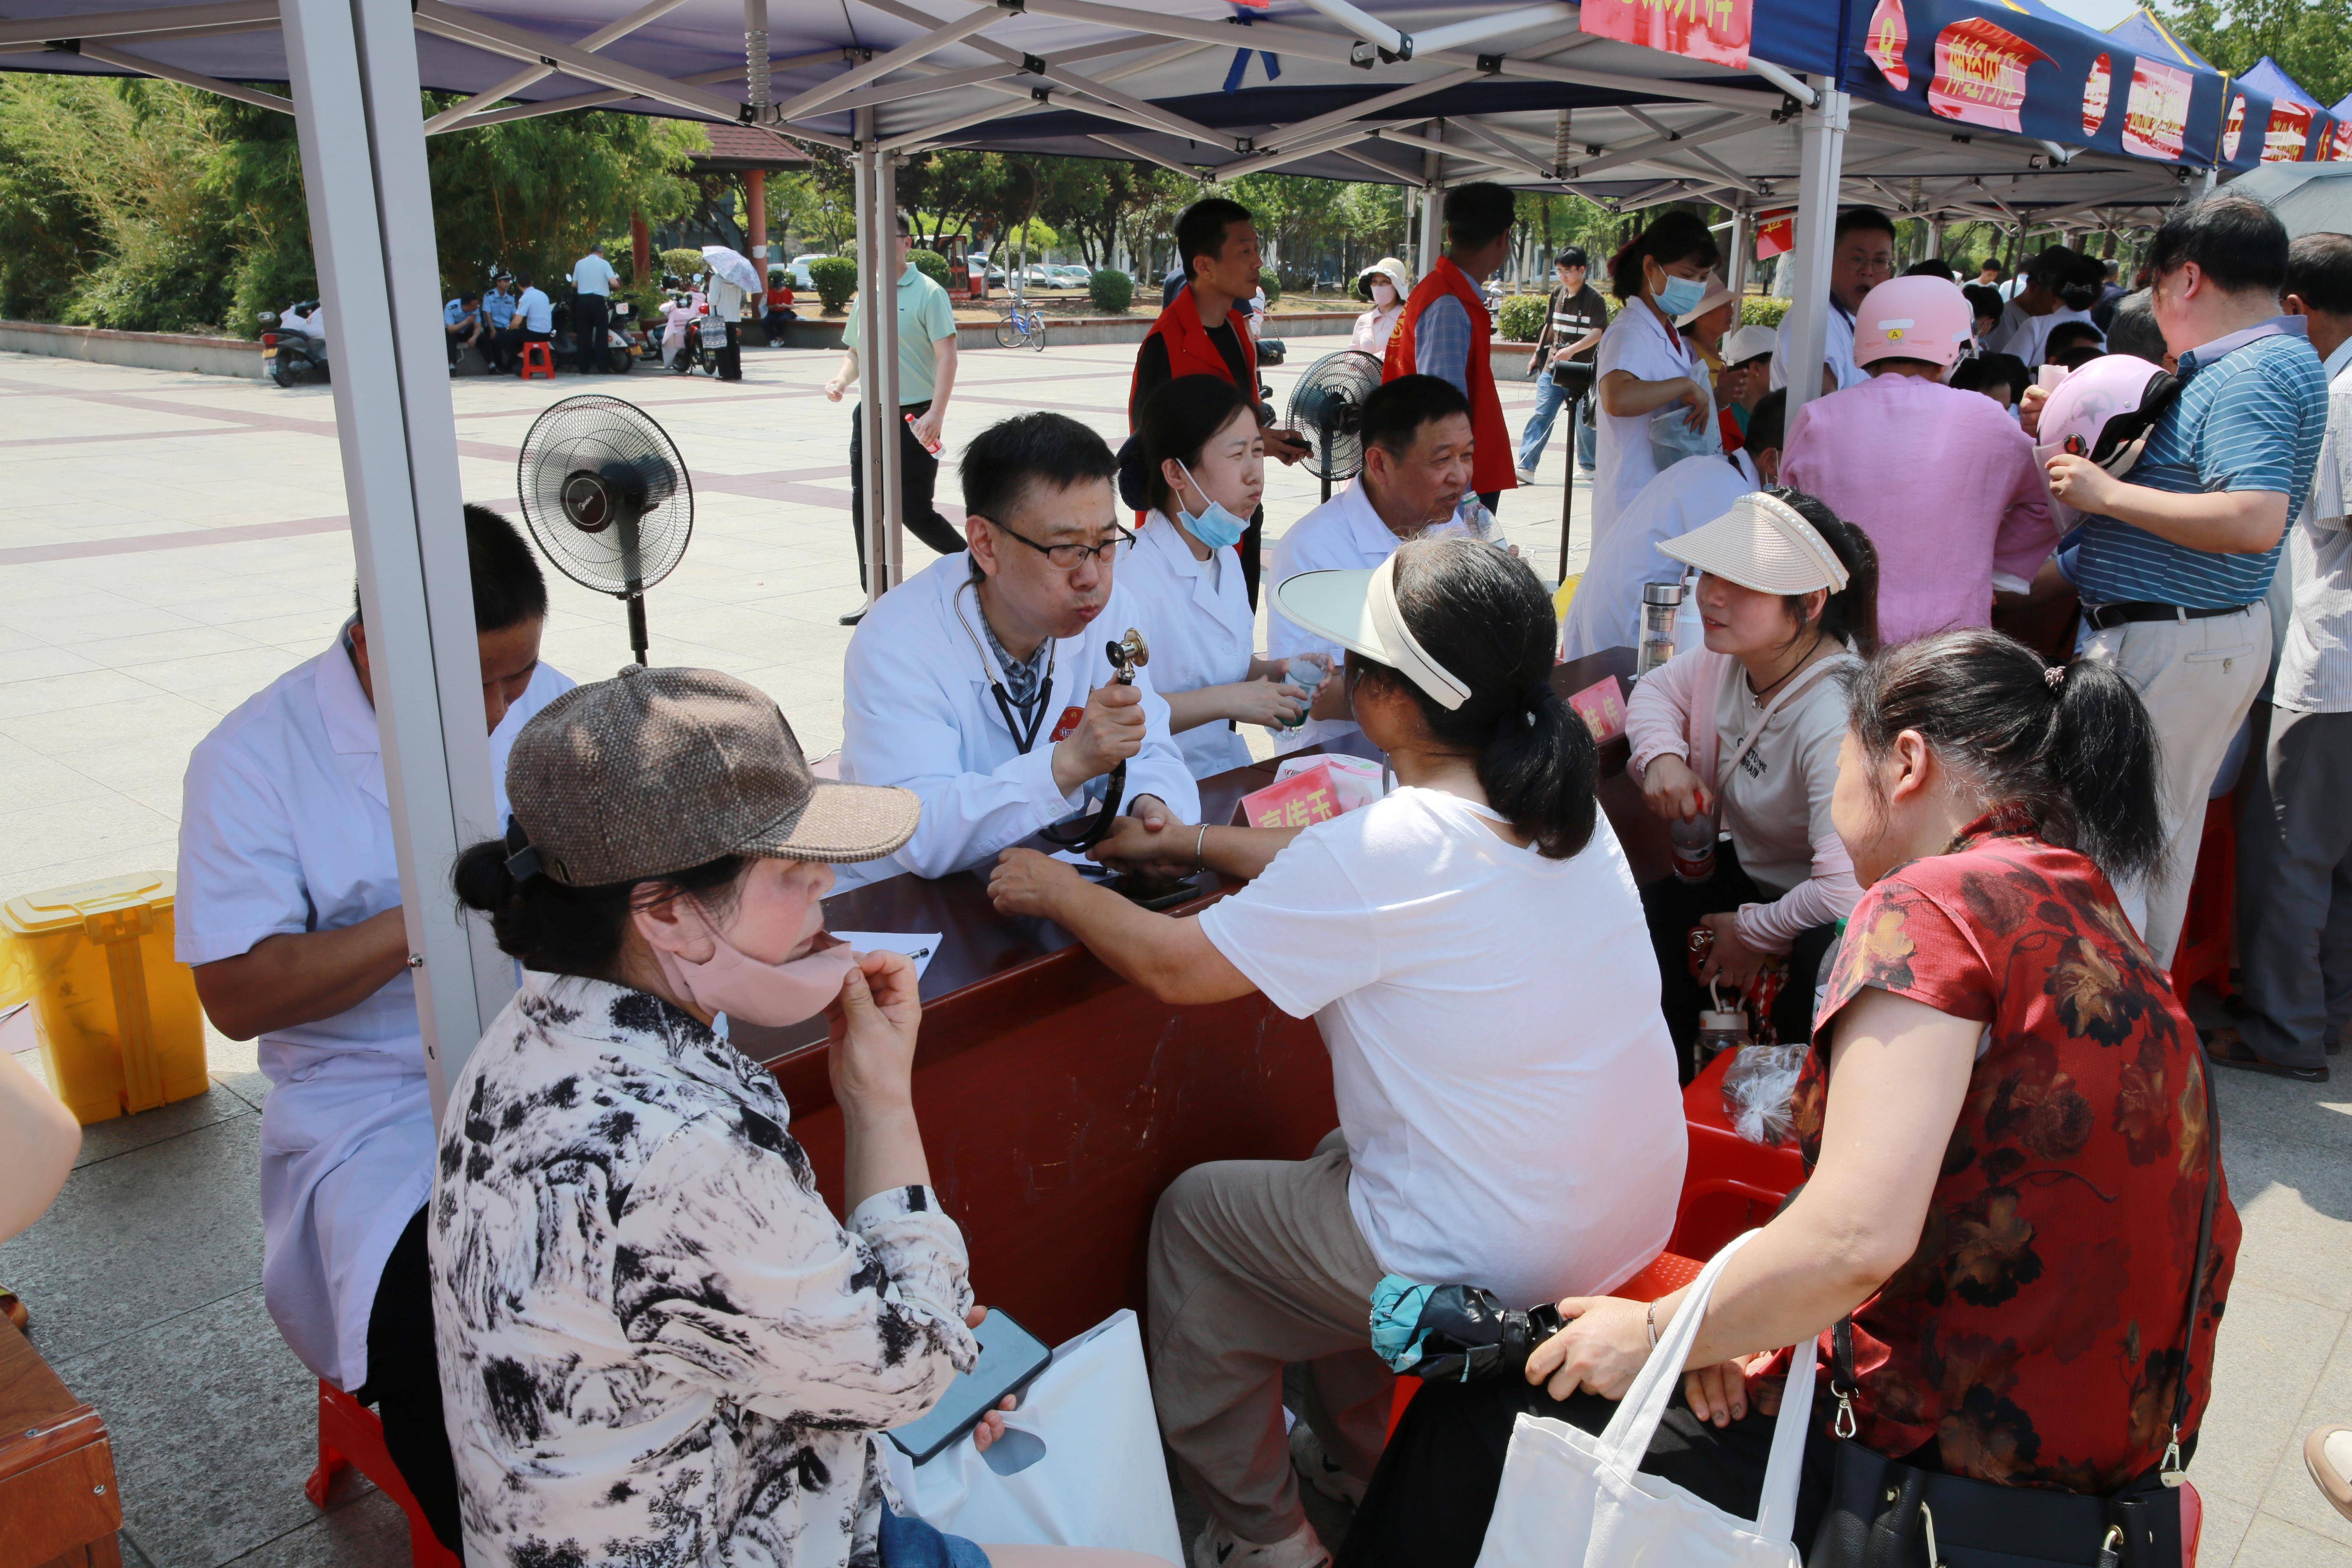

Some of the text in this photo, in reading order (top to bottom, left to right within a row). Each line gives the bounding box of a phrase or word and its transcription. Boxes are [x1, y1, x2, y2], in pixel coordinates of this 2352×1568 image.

[1878, 18, 1896, 69] 9
[1944, 34, 2024, 107] 神经内科
[578, 495, 593, 511] Midea
[1742, 755, 1759, 779] BRAIN
